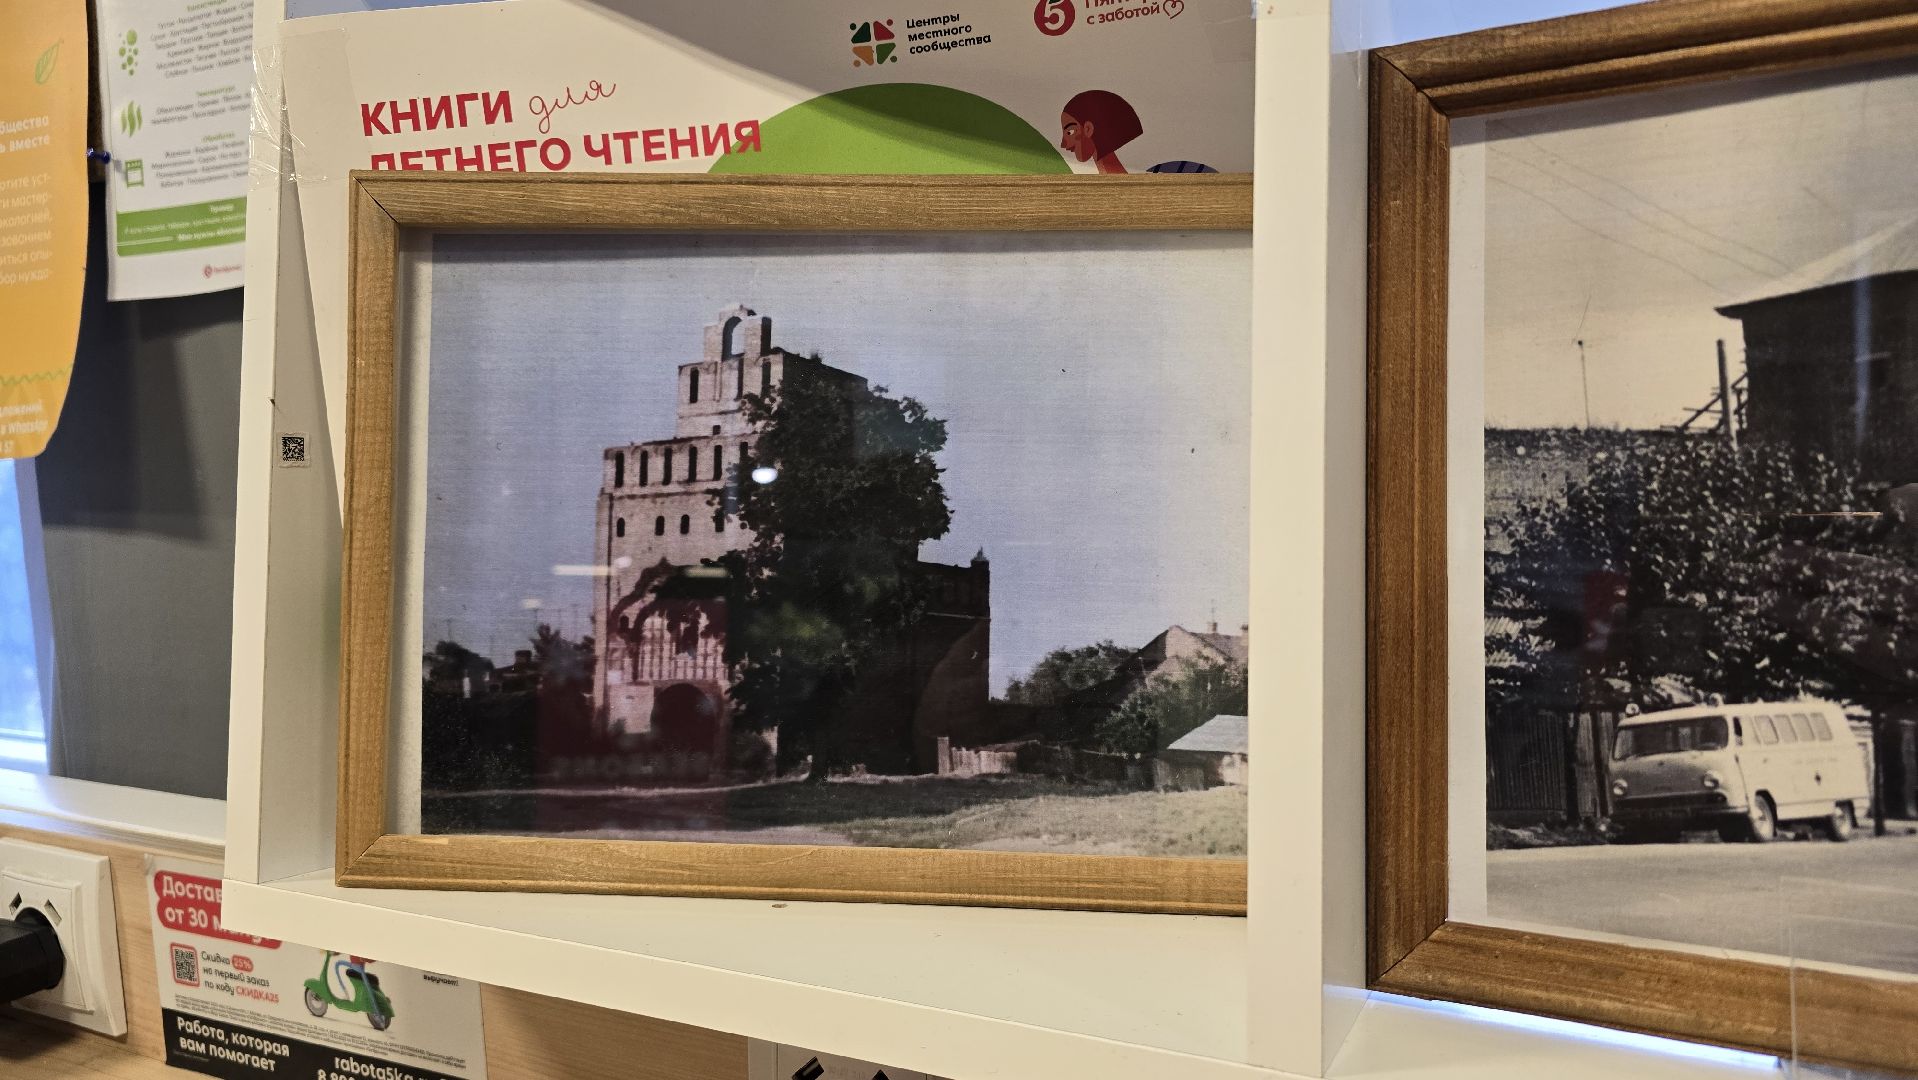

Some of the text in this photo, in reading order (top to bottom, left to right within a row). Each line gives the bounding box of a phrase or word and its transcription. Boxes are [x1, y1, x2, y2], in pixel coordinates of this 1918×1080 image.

[906, 13, 960, 29] Центры
[1086, 15, 1095, 25] с
[1099, 2, 1160, 24] заботой
[908, 25, 972, 42] местного
[909, 34, 992, 55] сообщества
[361, 79, 617, 137] КНИГИ для
[583, 119, 762, 166] ЧТЕНИЯ
[162, 875, 222, 903] Достав
[164, 906, 184, 924] от
[188, 907, 208, 929] 30
[201, 951, 230, 965] Скидка
[203, 967, 270, 987] на первый заказ
[205, 980, 214, 989] по
[216, 982, 234, 996] коду
[176, 1016, 229, 1045] Работа,
[231, 1032, 290, 1058] которая
[179, 1037, 206, 1055] вам
[209, 1043, 276, 1073] помогает
[334, 1057, 433, 1080] rabota5ka
